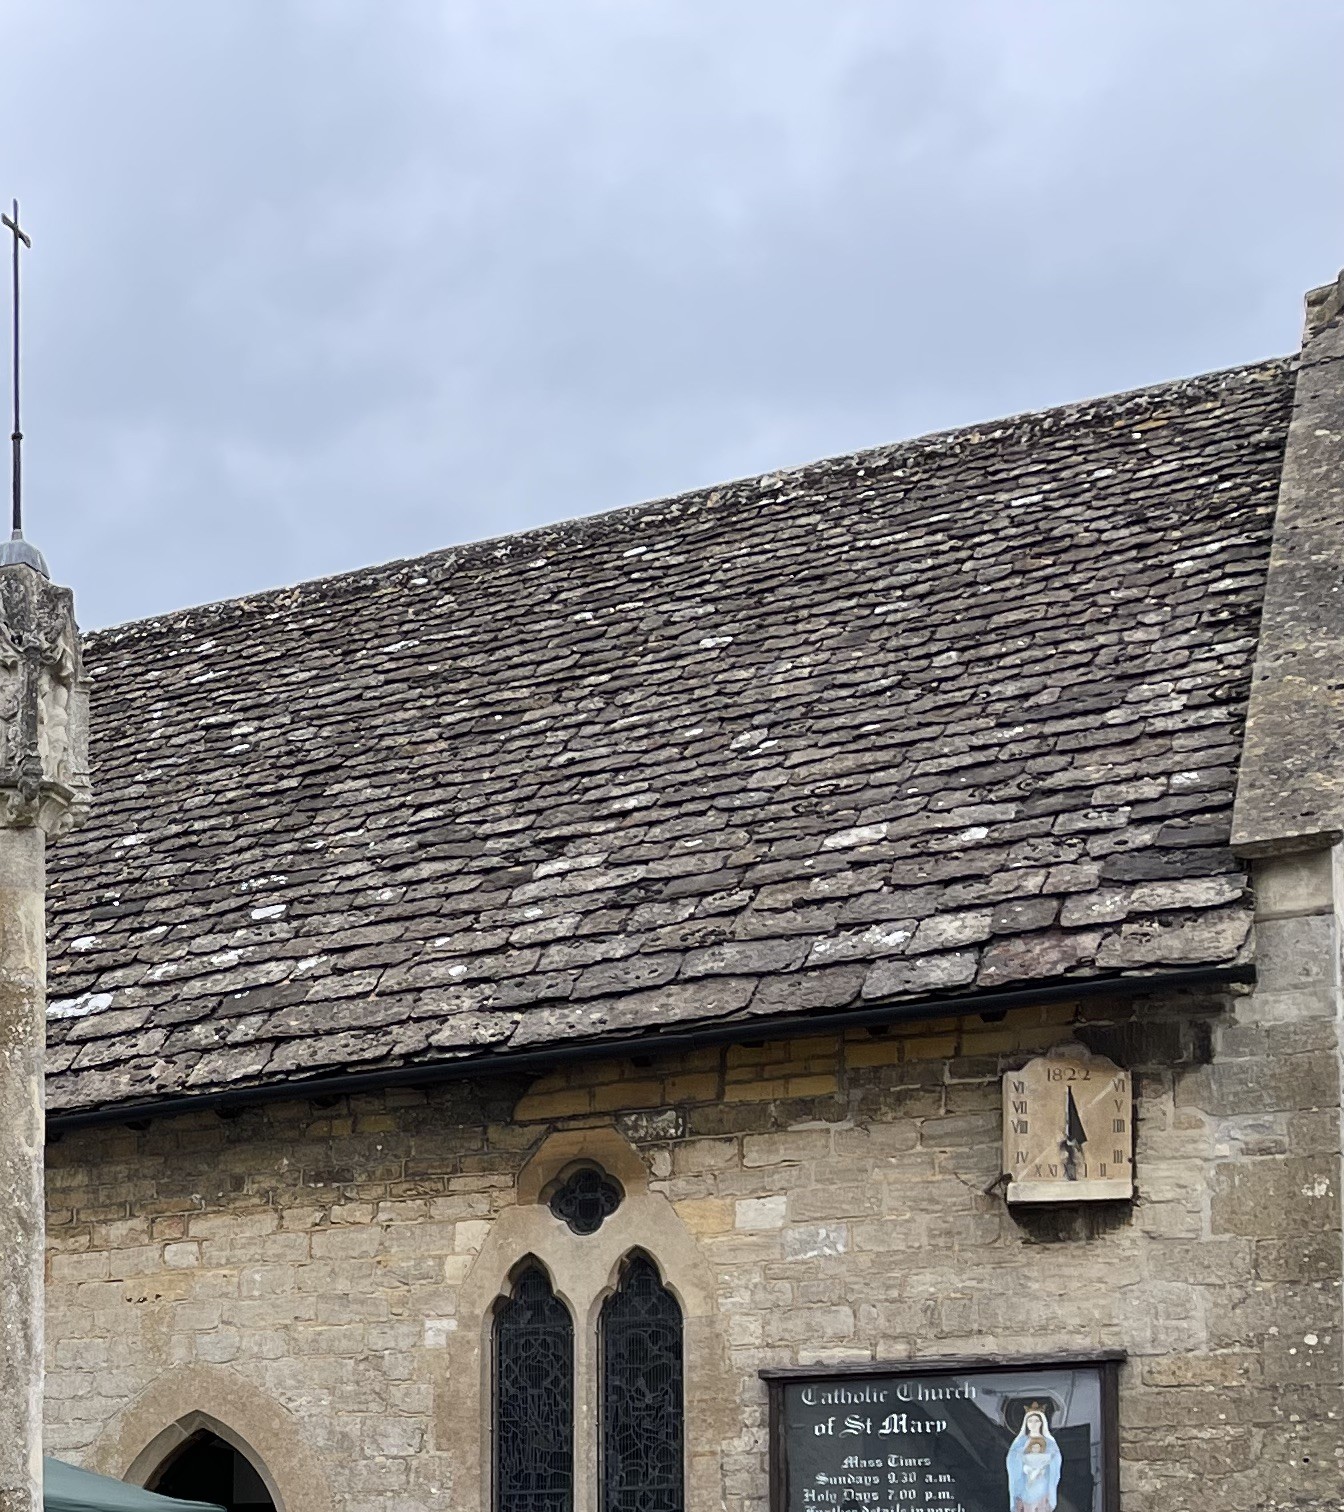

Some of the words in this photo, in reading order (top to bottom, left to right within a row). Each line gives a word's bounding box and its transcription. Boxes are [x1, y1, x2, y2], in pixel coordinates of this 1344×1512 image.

[1046, 1068, 1091, 1082] 1822
[801, 1384, 889, 1406] Catholic
[896, 1381, 977, 1403] Church
[814, 1416, 836, 1437] of
[838, 1414, 873, 1439] St
[878, 1412, 948, 1440] Mary
[841, 1455, 884, 1469] Mass
[887, 1453, 932, 1468] Times
[815, 1471, 880, 1487] Sundays
[887, 1471, 917, 1485] 9.30
[924, 1473, 956, 1484] a.m.
[802, 1488, 838, 1504] Holy
[842, 1488, 879, 1503] Days
[887, 1488, 917, 1501] 7.00
[924, 1489, 955, 1502] p.m.
